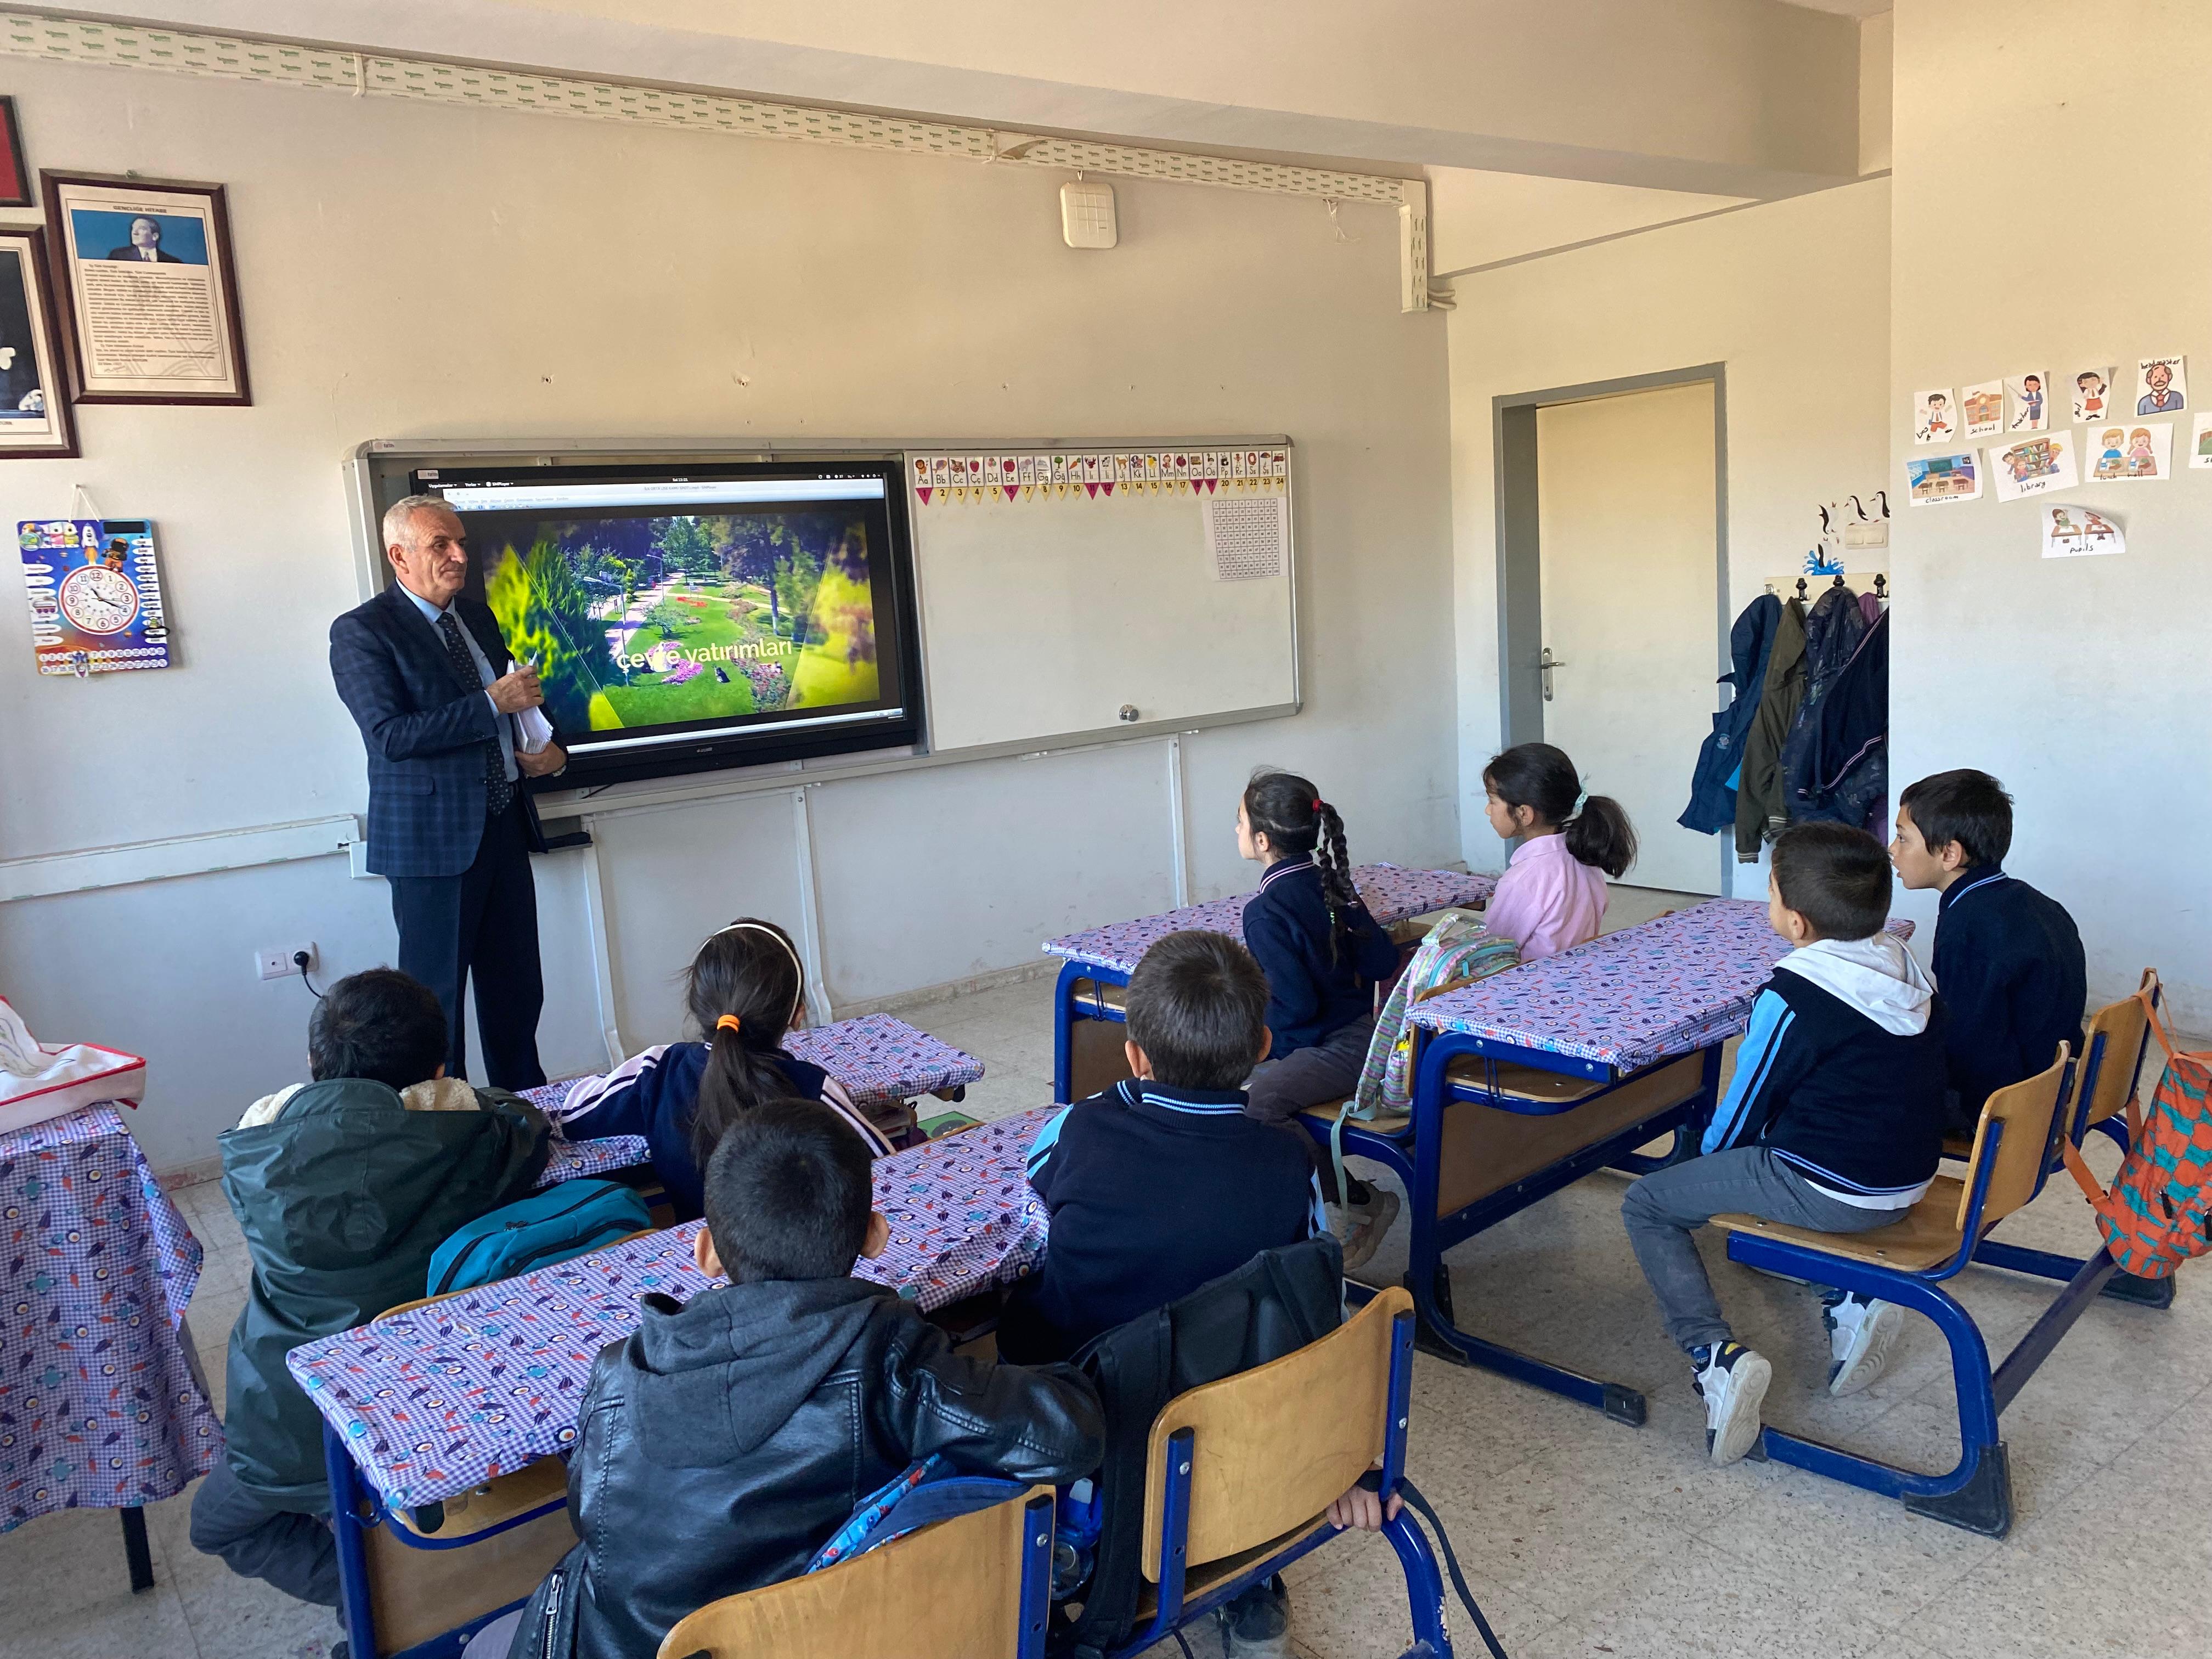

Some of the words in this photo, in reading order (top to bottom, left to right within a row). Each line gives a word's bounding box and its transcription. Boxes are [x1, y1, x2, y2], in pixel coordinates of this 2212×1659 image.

[2141, 359, 2181, 369] headmaster
[2011, 407, 2029, 429] teacher
[1970, 424, 1995, 435] school
[918, 476, 928, 484] Aa
[936, 475, 946, 484] Bb
[952, 474, 964, 483] Cc
[970, 473, 981, 484] Çç
[987, 473, 998, 482] Dd
[1006, 472, 1014, 482] Ee
[1023, 472, 1031, 481] Ff
[1037, 472, 1048, 484] Gg
[1054, 469, 1065, 484] Ğğ
[1070, 471, 1081, 479] Hh
[1119, 470, 1126, 482] Jj
[1133, 469, 1142, 478] Kk
[1149, 469, 1156, 478] Ll
[1161, 469, 1174, 477] Mm
[1177, 468, 1187, 477] Nn
[1192, 467, 1201, 476] Oo
[1221, 467, 1228, 478] Pp
[1235, 467, 1243, 475] Rr
[1250, 466, 1256, 475] Ss
[1276, 465, 1282, 473] Tt
[2100, 472, 2117, 480] lunch
[2021, 481, 2046, 493] library
[1925, 495, 1959, 504] classroom
[2069, 543, 2094, 554] pupils
[616, 649, 681, 674] çevre
[685, 638, 792, 669] yatırımları
